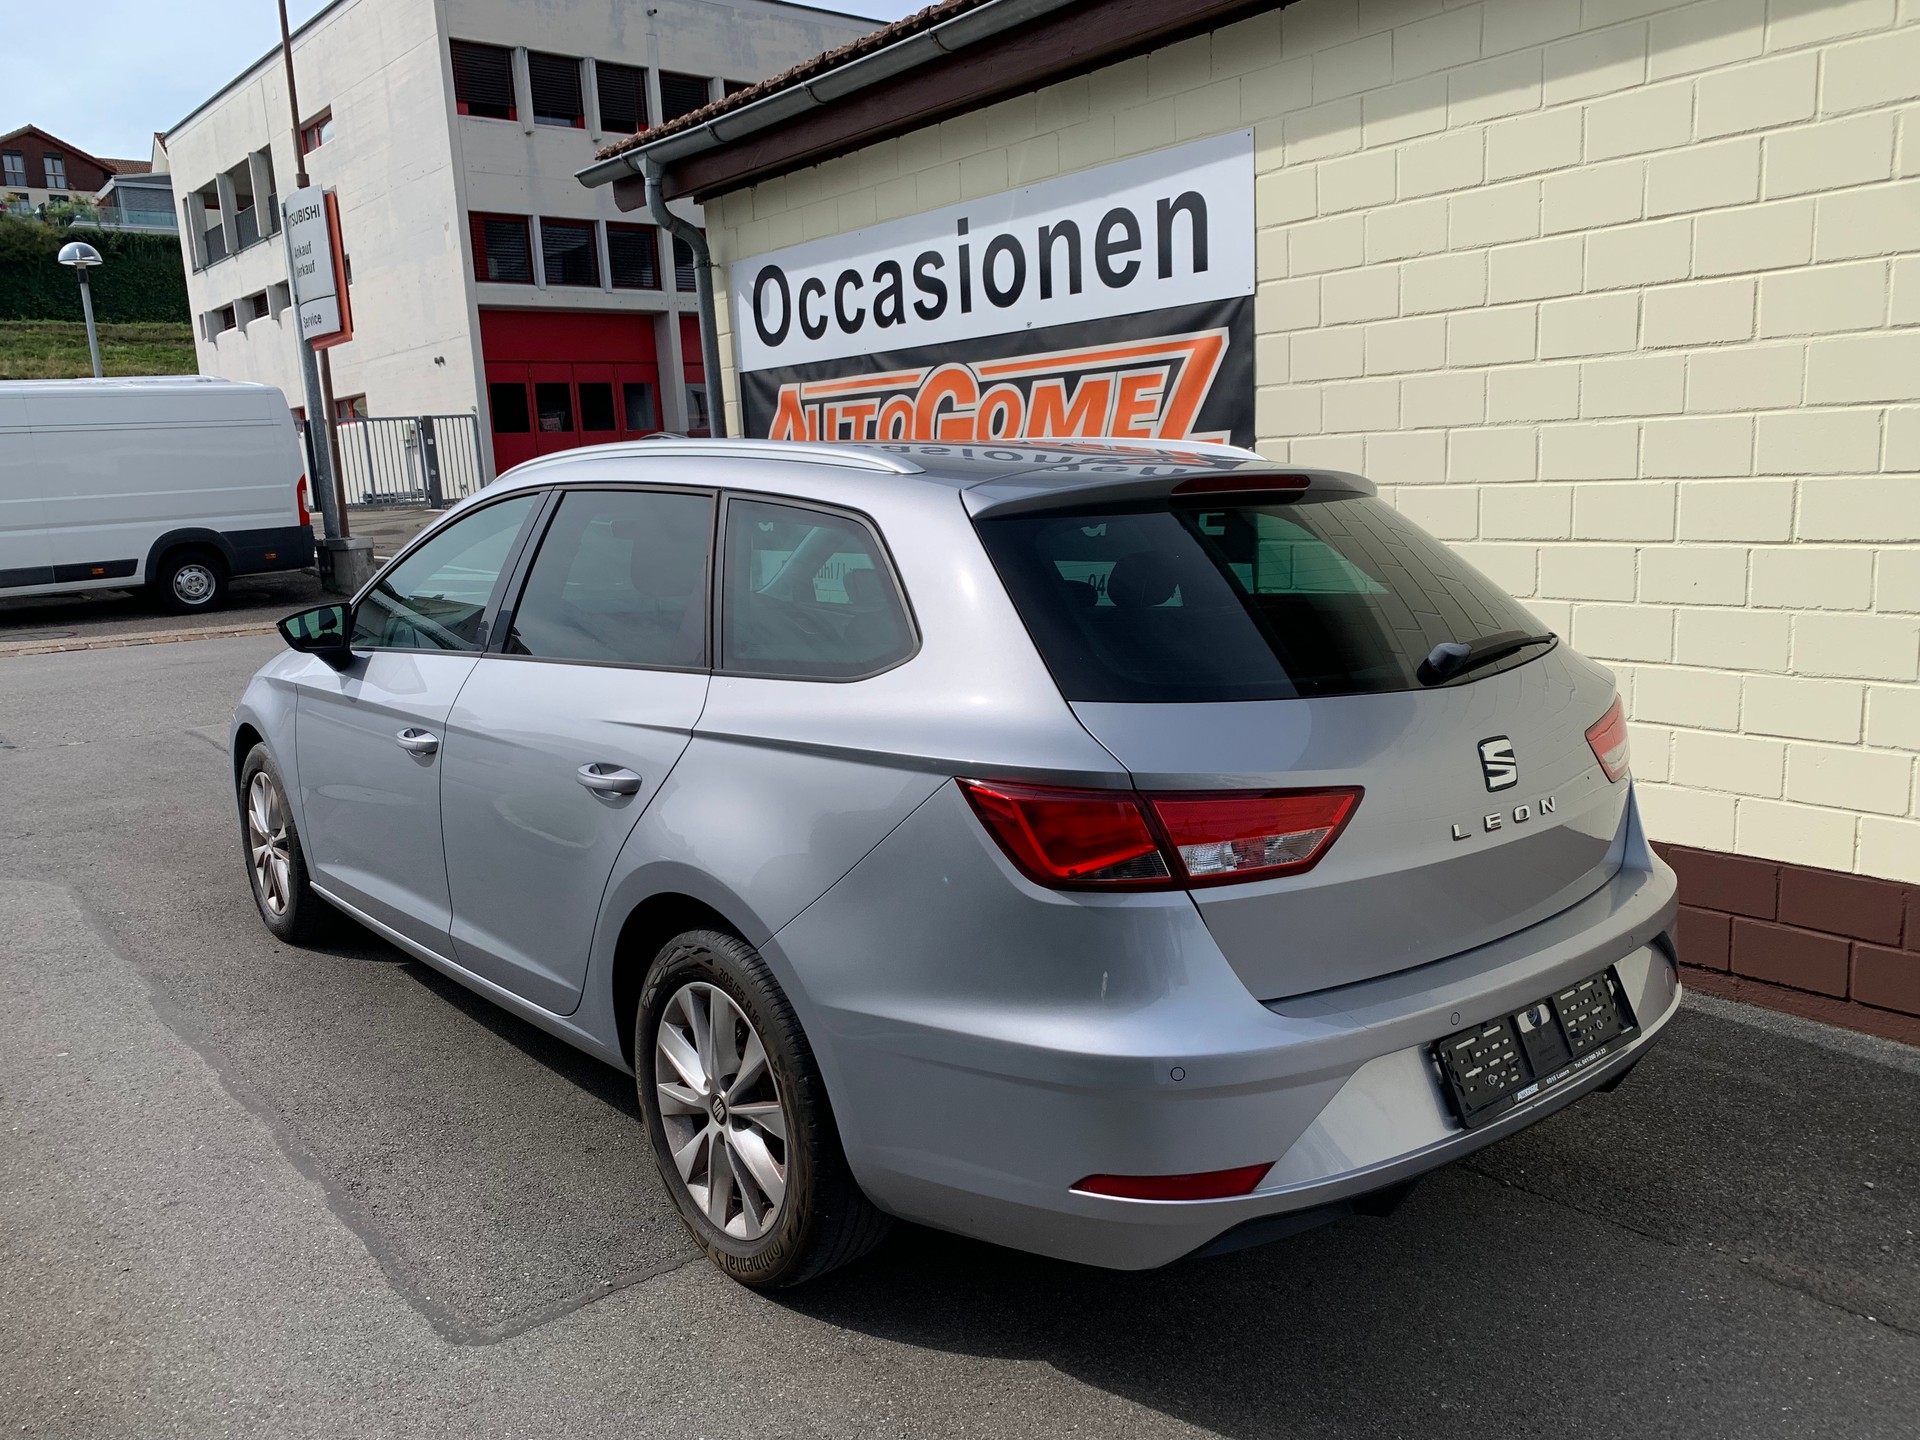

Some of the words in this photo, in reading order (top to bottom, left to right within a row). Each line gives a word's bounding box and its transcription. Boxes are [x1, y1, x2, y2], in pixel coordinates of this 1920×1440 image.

[753, 190, 1209, 347] Occasionen
[303, 313, 322, 329] Service
[1452, 796, 1556, 841] LEON
[724, 1237, 785, 1275] Continental
